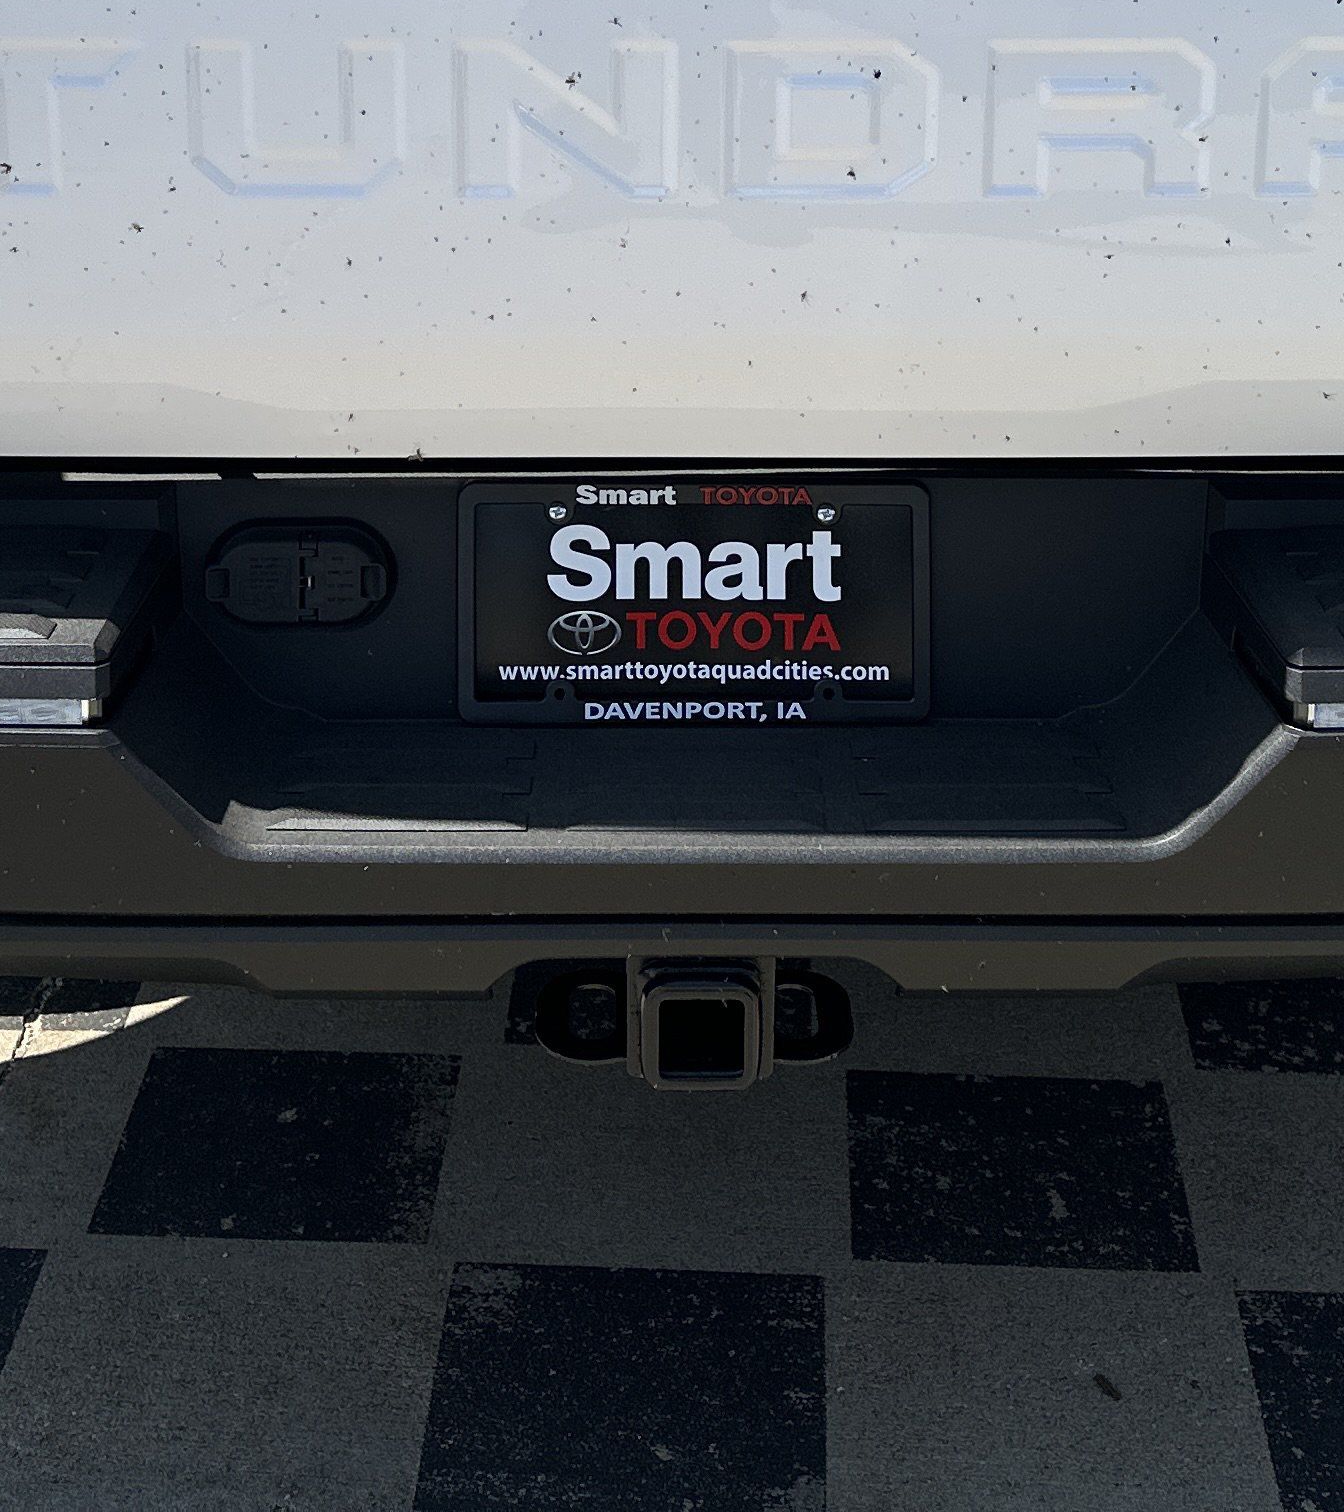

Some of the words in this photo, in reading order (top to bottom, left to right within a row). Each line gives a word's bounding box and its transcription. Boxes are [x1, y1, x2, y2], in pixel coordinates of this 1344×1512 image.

[576, 484, 677, 505] Smart
[700, 487, 812, 505] TOYOTA
[547, 524, 842, 602] Smart
[626, 611, 842, 651] TOYOTA
[498, 660, 890, 684] www.smarttoyotaquadcities.com
[584, 702, 768, 722] DAVENPORT,
[777, 703, 807, 720] IA
